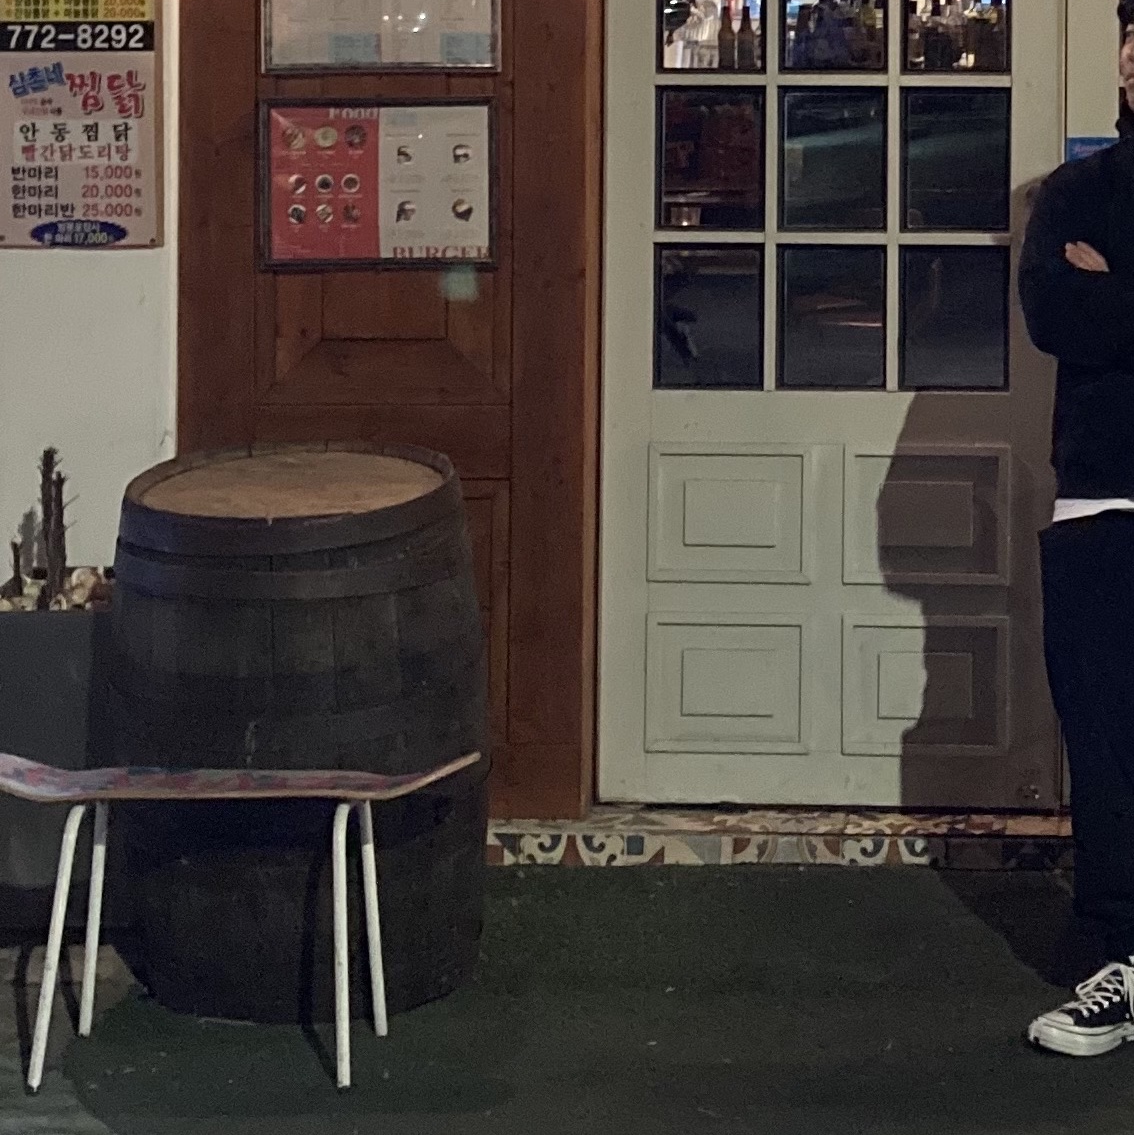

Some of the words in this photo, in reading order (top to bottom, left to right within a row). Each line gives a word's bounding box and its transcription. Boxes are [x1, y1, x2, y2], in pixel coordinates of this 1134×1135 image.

[7, 24, 145, 49] 772-8292
[11, 166, 58, 181] 반마리
[11, 184, 59, 199] 한마리
[12, 203, 75, 219] 한마리반
